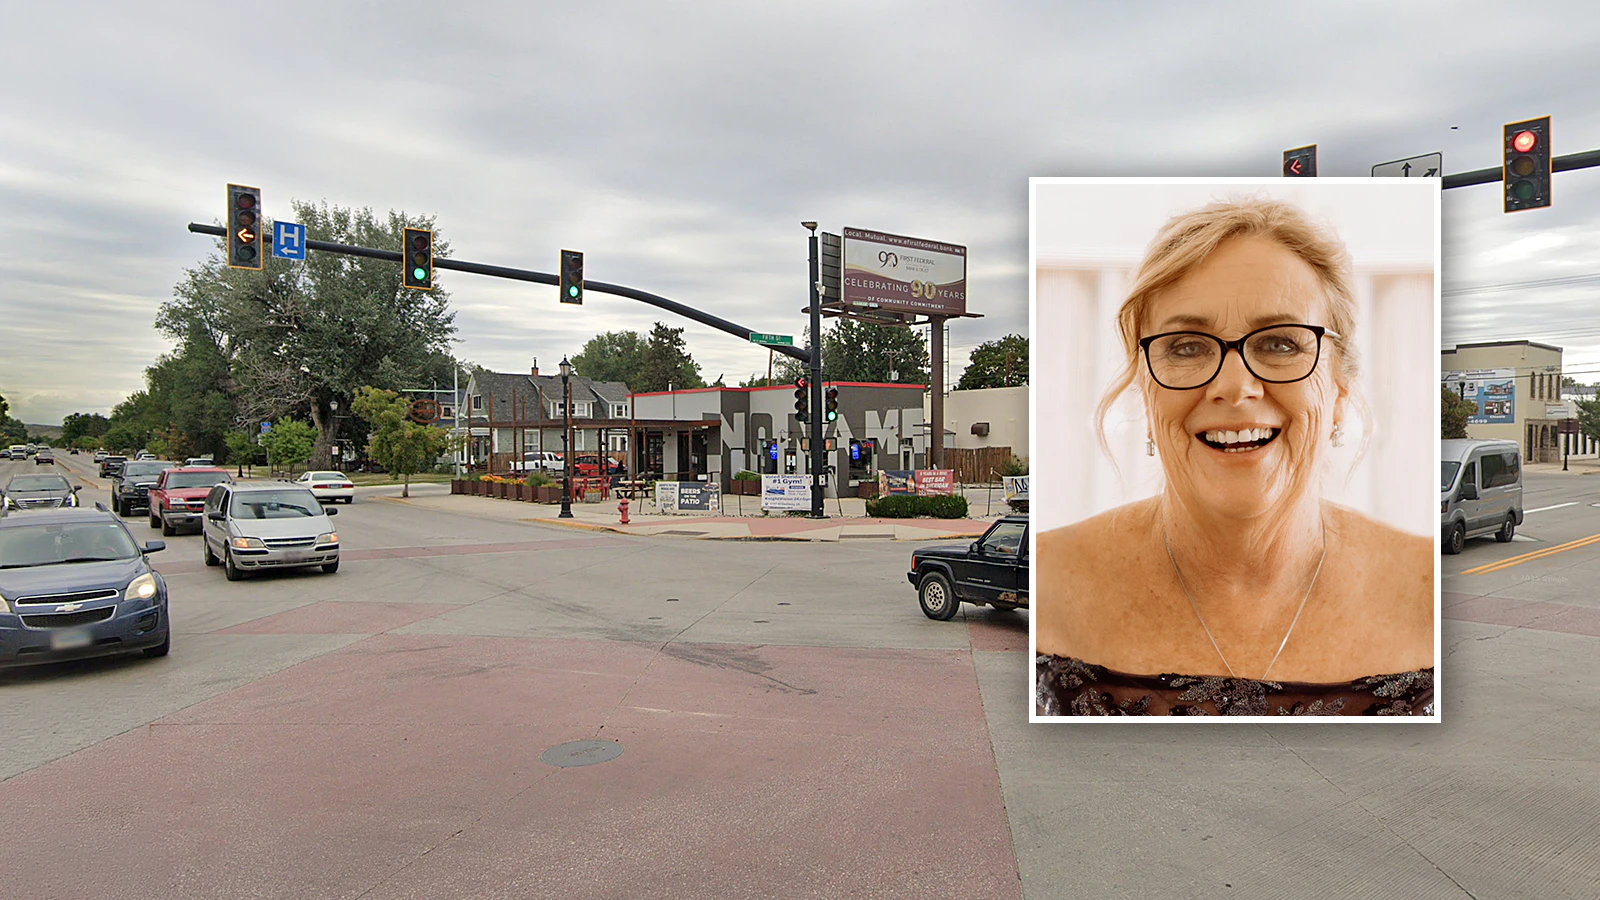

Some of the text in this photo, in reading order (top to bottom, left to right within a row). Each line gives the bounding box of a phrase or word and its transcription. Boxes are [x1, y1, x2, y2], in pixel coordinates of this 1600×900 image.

[280, 224, 299, 247] H
[845, 229, 864, 238] Local.
[900, 254, 935, 266] FIRST FEDERAL
[844, 277, 965, 300] CELEBRATING 90 YEARS
[876, 297, 909, 305] COMMUNITY
[910, 300, 945, 310] COMMITMENT
